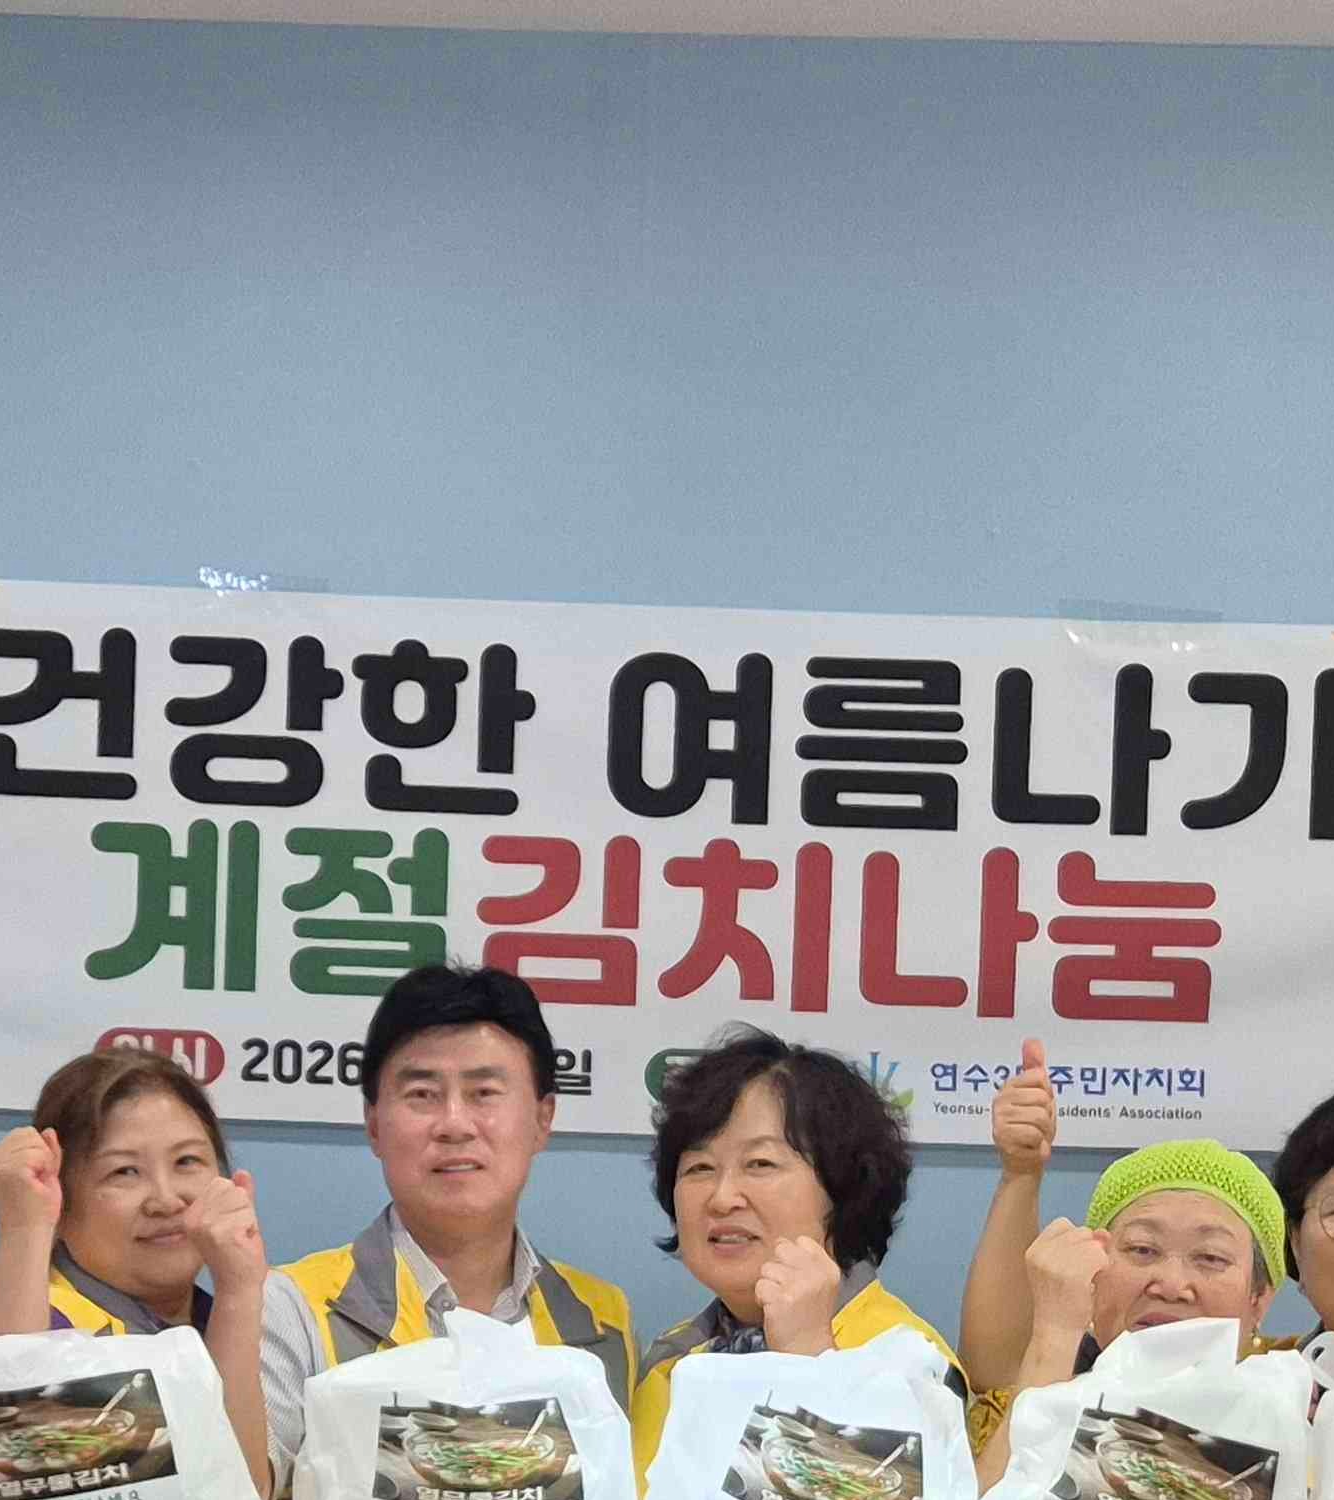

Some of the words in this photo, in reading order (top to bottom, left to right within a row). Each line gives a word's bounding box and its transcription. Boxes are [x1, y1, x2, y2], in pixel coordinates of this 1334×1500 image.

[86, 817, 1222, 1022] 계절김치나눔
[930, 1063, 1024, 1093] 연수3
[1048, 1066, 1205, 1097] 주민자치회
[1119, 1107, 1202, 1120] Association
